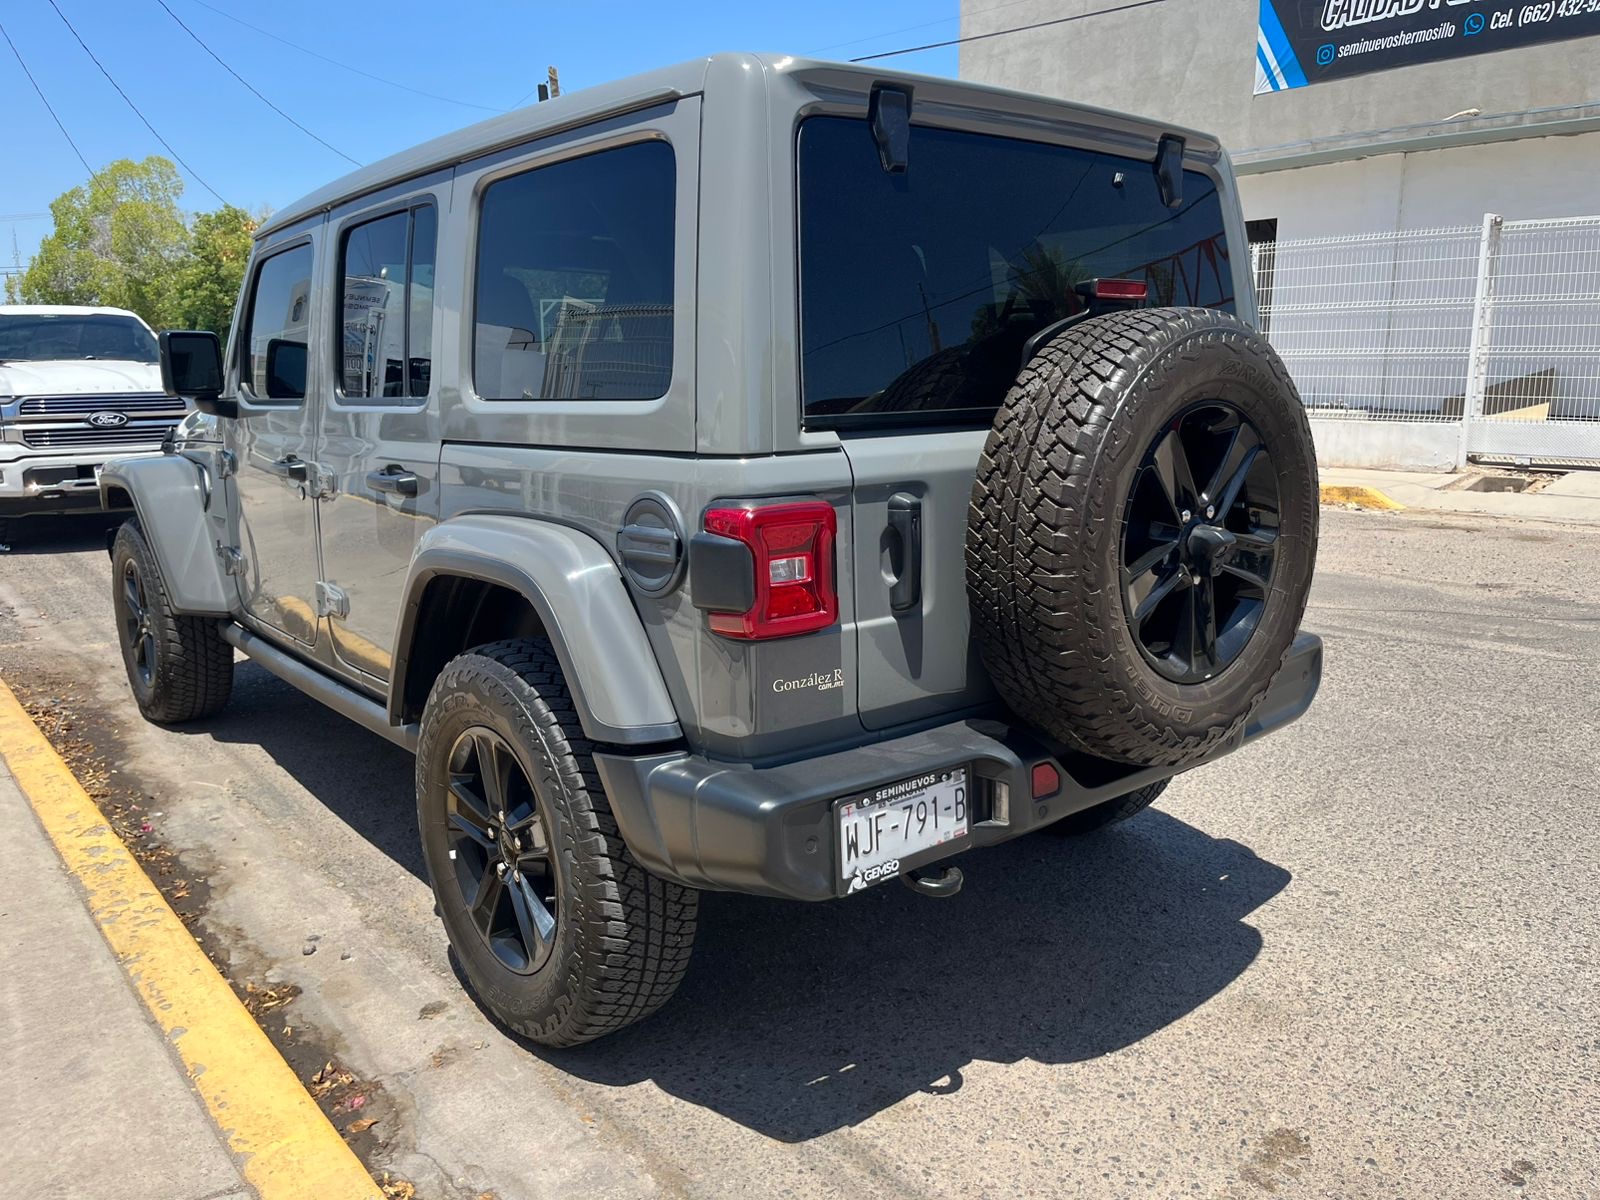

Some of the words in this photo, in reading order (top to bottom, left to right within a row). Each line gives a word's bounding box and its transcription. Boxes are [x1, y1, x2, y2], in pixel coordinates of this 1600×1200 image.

[1489, 8, 1514, 30] Cel.
[1517, 0, 1557, 28] (662)
[1337, 21, 1456, 58] seminuevoshermosillo
[97, 413, 121, 425] Ford
[772, 673, 832, 693] González
[833, 668, 842, 681] R
[817, 680, 845, 691] com.mx
[875, 774, 936, 801] SEMINUEVOS
[845, 786, 966, 862] WJF-791-B
[864, 859, 900, 882] GEMSO
